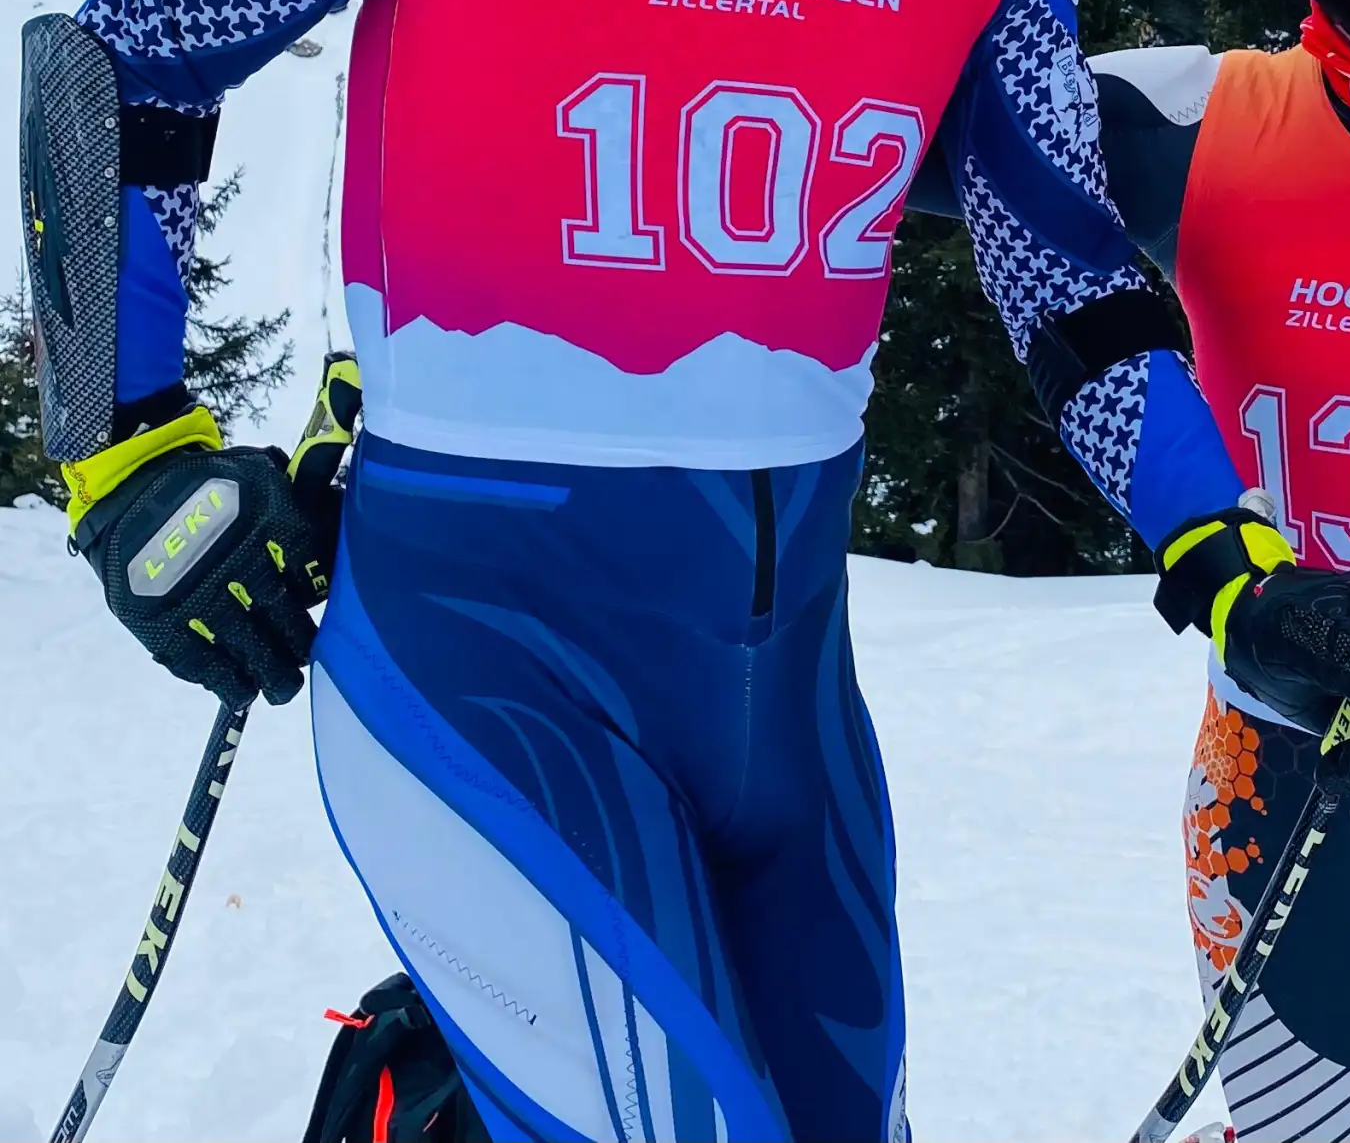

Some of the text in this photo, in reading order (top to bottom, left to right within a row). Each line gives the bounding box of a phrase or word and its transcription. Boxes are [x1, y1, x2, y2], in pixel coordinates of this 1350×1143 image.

[556, 71, 926, 280] 102
[144, 489, 224, 580] LEKI
[125, 820, 201, 1004] LEKI
[1178, 962, 1248, 1098] LEKI
